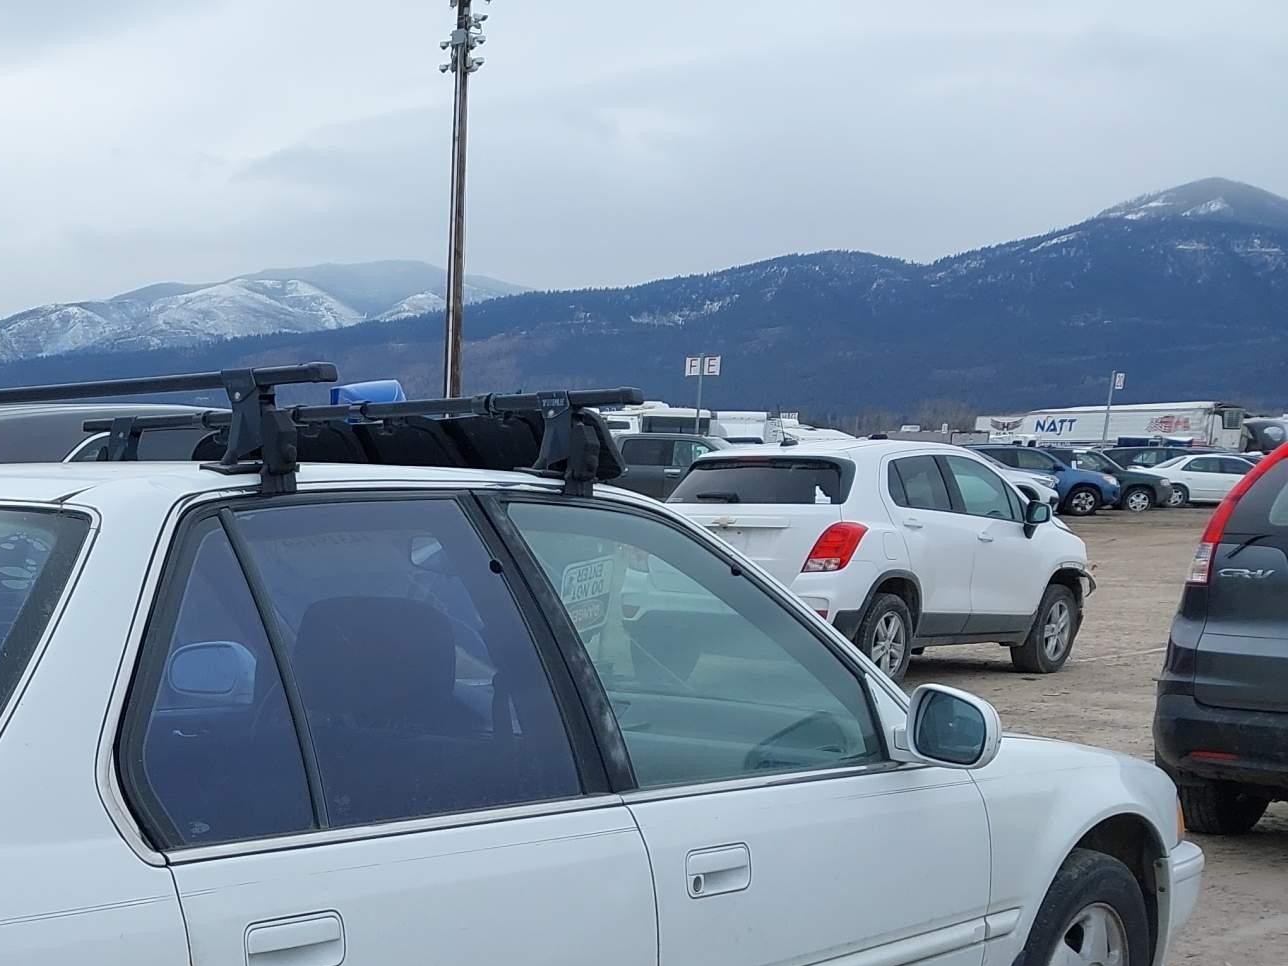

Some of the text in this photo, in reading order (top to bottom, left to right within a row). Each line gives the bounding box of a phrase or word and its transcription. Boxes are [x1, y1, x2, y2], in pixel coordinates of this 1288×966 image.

[689, 358, 699, 374] F
[707, 358, 717, 374] E
[1034, 417, 1078, 436] NATT
[577, 563, 604, 583] ENTER
[572, 579, 604, 600] DO NOT
